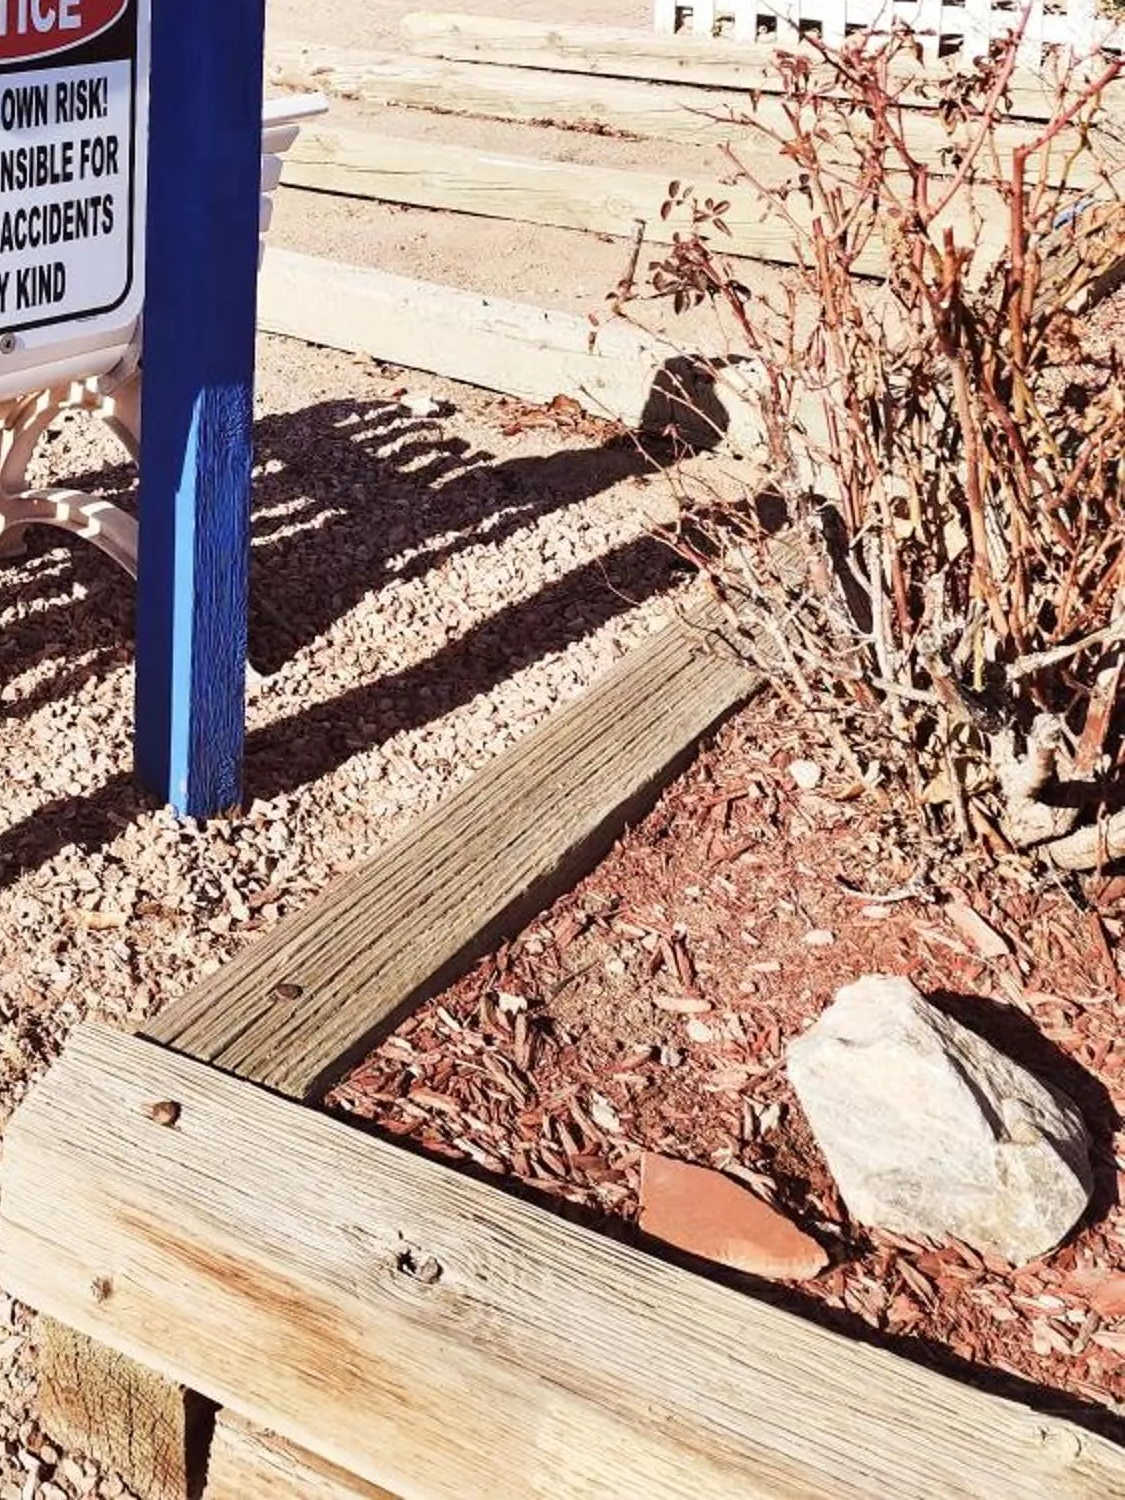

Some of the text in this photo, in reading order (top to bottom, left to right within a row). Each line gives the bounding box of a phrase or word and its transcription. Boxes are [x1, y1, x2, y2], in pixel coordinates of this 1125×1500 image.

[1, 84, 48, 131] OWN
[55, 77, 107, 123] RISK!
[80, 136, 118, 179] FOR
[0, 194, 113, 253] ACCIDENTS
[17, 262, 65, 310] KIND
